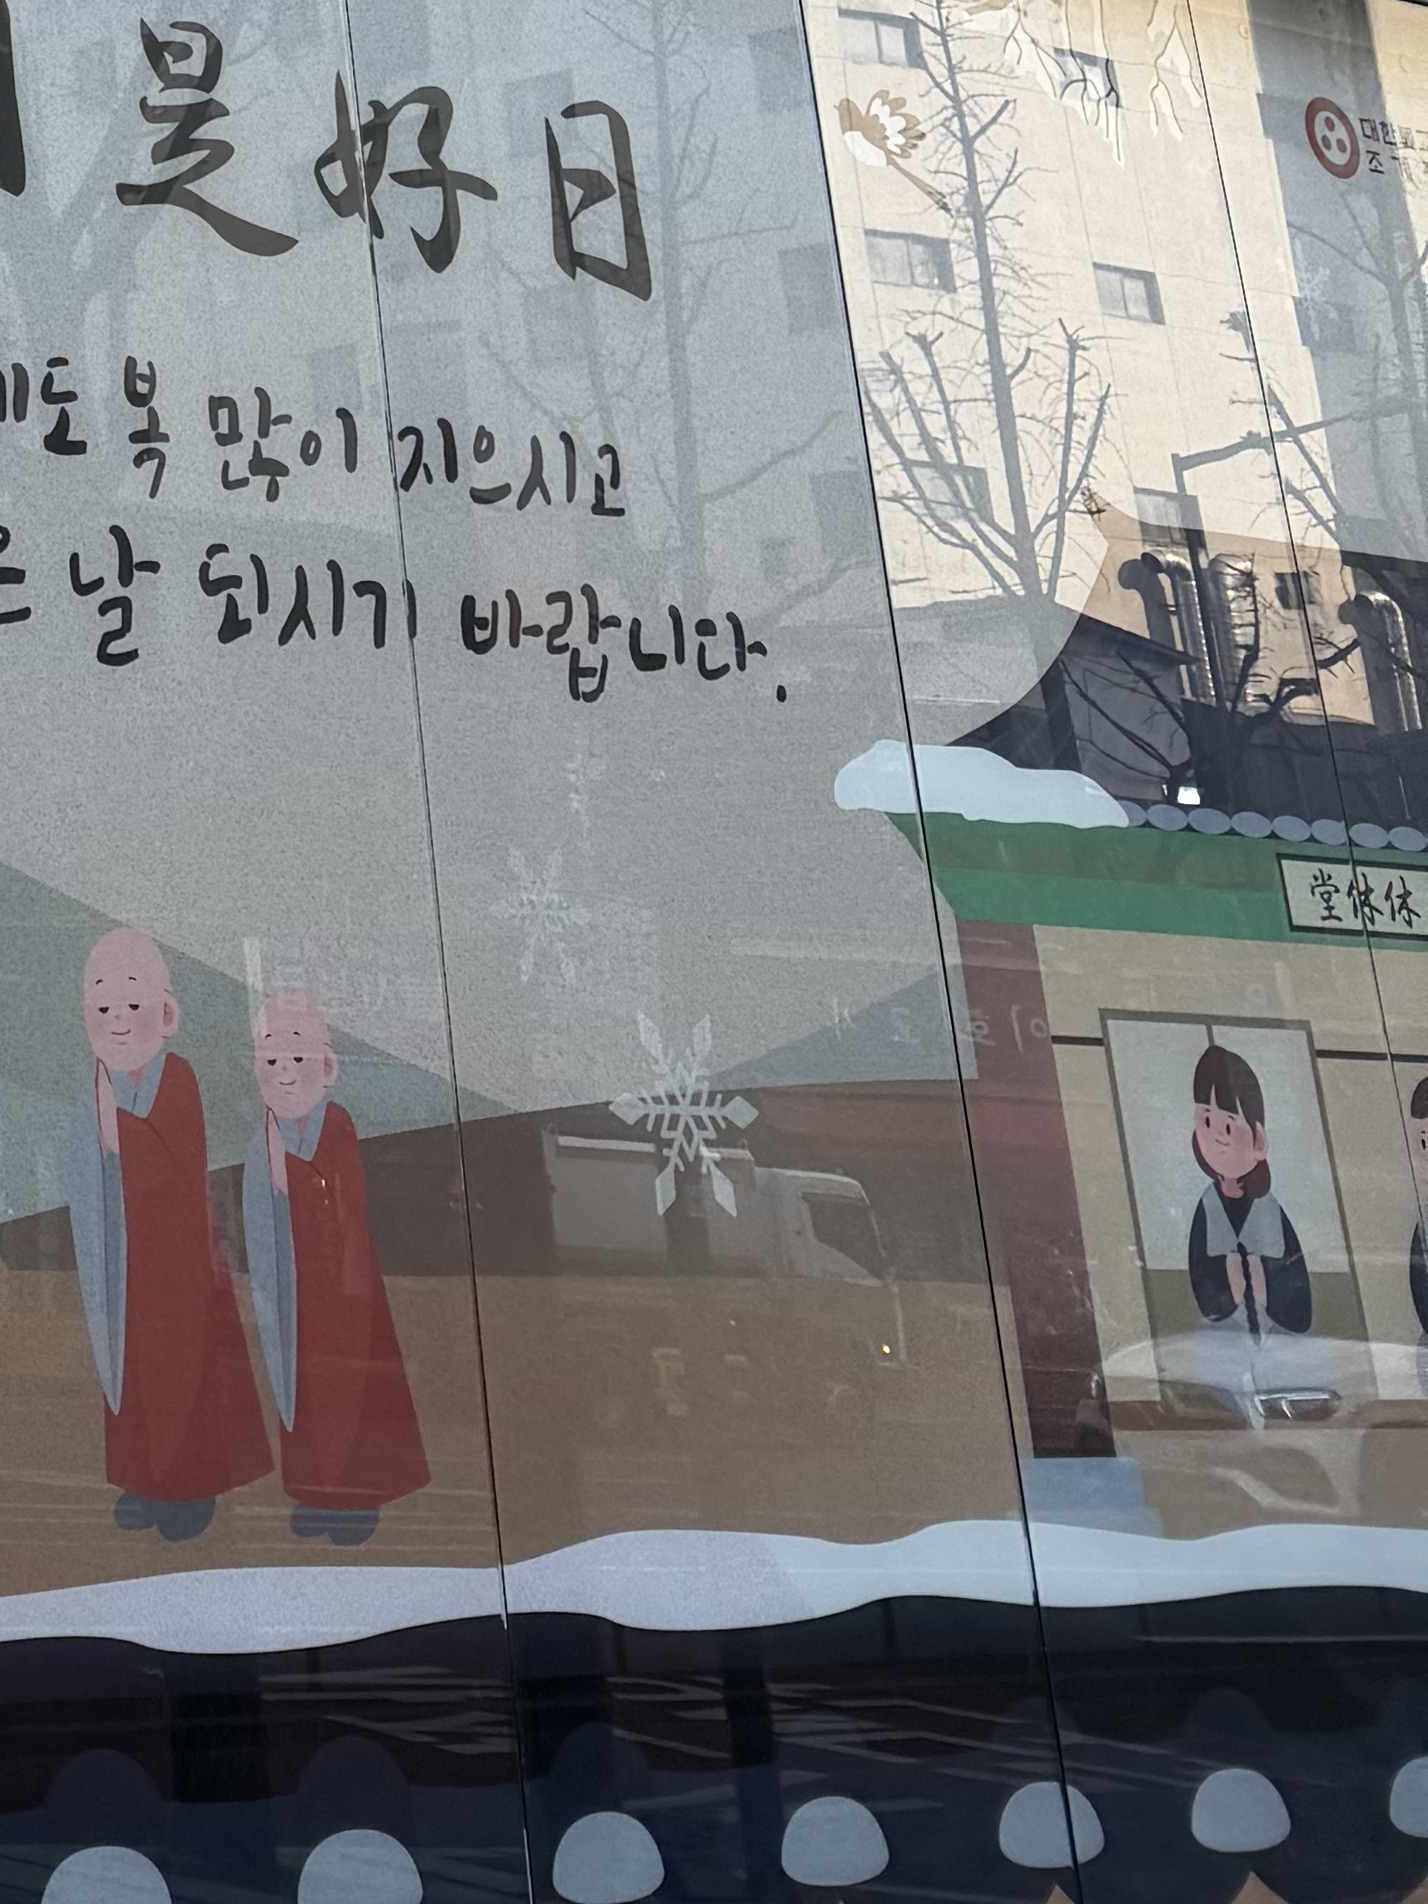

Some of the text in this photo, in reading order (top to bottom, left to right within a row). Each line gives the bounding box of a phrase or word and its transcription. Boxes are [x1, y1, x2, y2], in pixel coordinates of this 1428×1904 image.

[122, 355, 170, 499] 복
[208, 386, 358, 503] 많이
[397, 417, 626, 518] 지으시고
[68, 524, 161, 667] 날
[198, 542, 418, 650] 되시기
[460, 582, 789, 704] 바랍니다.
